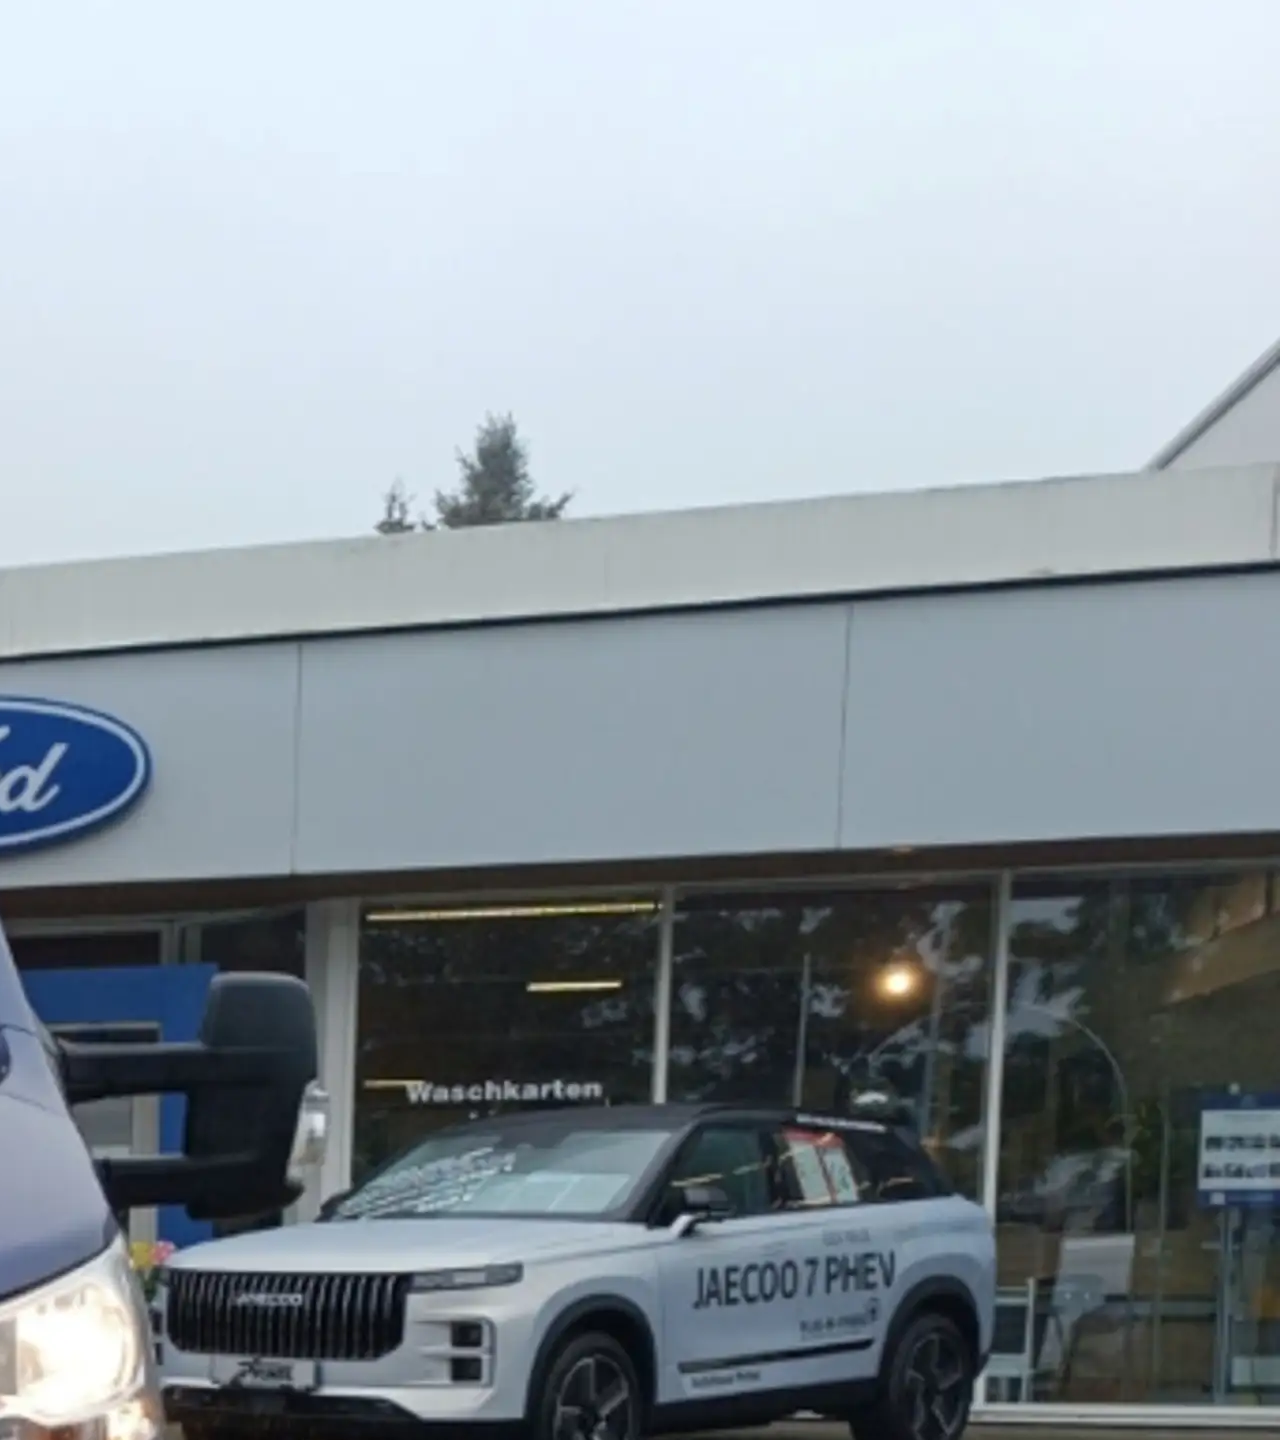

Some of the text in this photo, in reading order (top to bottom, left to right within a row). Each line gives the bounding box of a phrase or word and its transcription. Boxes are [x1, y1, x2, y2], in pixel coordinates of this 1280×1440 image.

[405, 1079, 603, 1103] Waschkarten
[692, 1250, 897, 1310] JAECOO 7 PHEV
